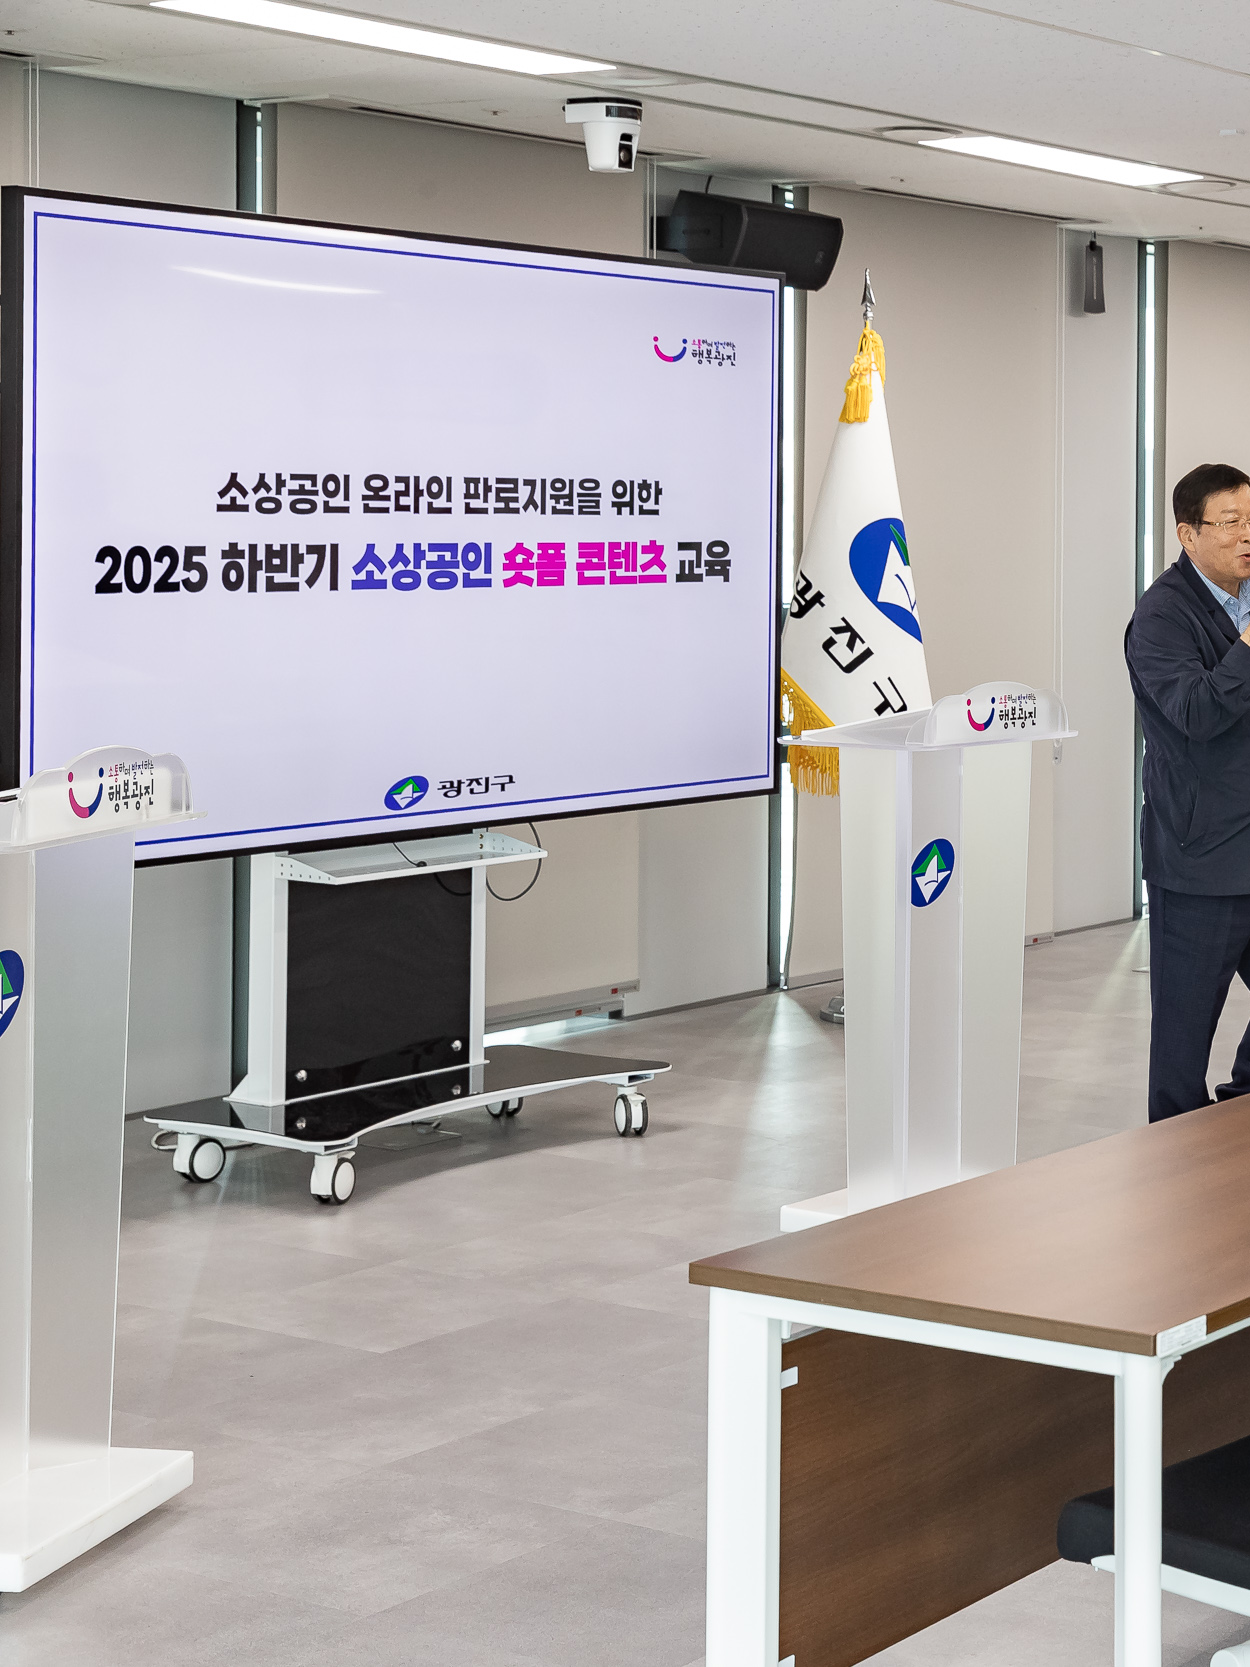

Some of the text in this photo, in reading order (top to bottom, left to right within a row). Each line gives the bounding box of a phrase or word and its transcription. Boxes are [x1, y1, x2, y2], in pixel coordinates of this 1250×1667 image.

[691, 348, 736, 367] 행복광진
[216, 472, 663, 516] 소상공인 온라인 판로지원을 위한
[94, 539, 732, 594] 2025 하반기 소상공인 숏폼 콘텐츠 교육
[998, 706, 1037, 730] 행복광진
[108, 759, 154, 783] 소통하며 발전하는
[108, 778, 154, 813] 행복광진
[437, 774, 516, 799] 광진구
